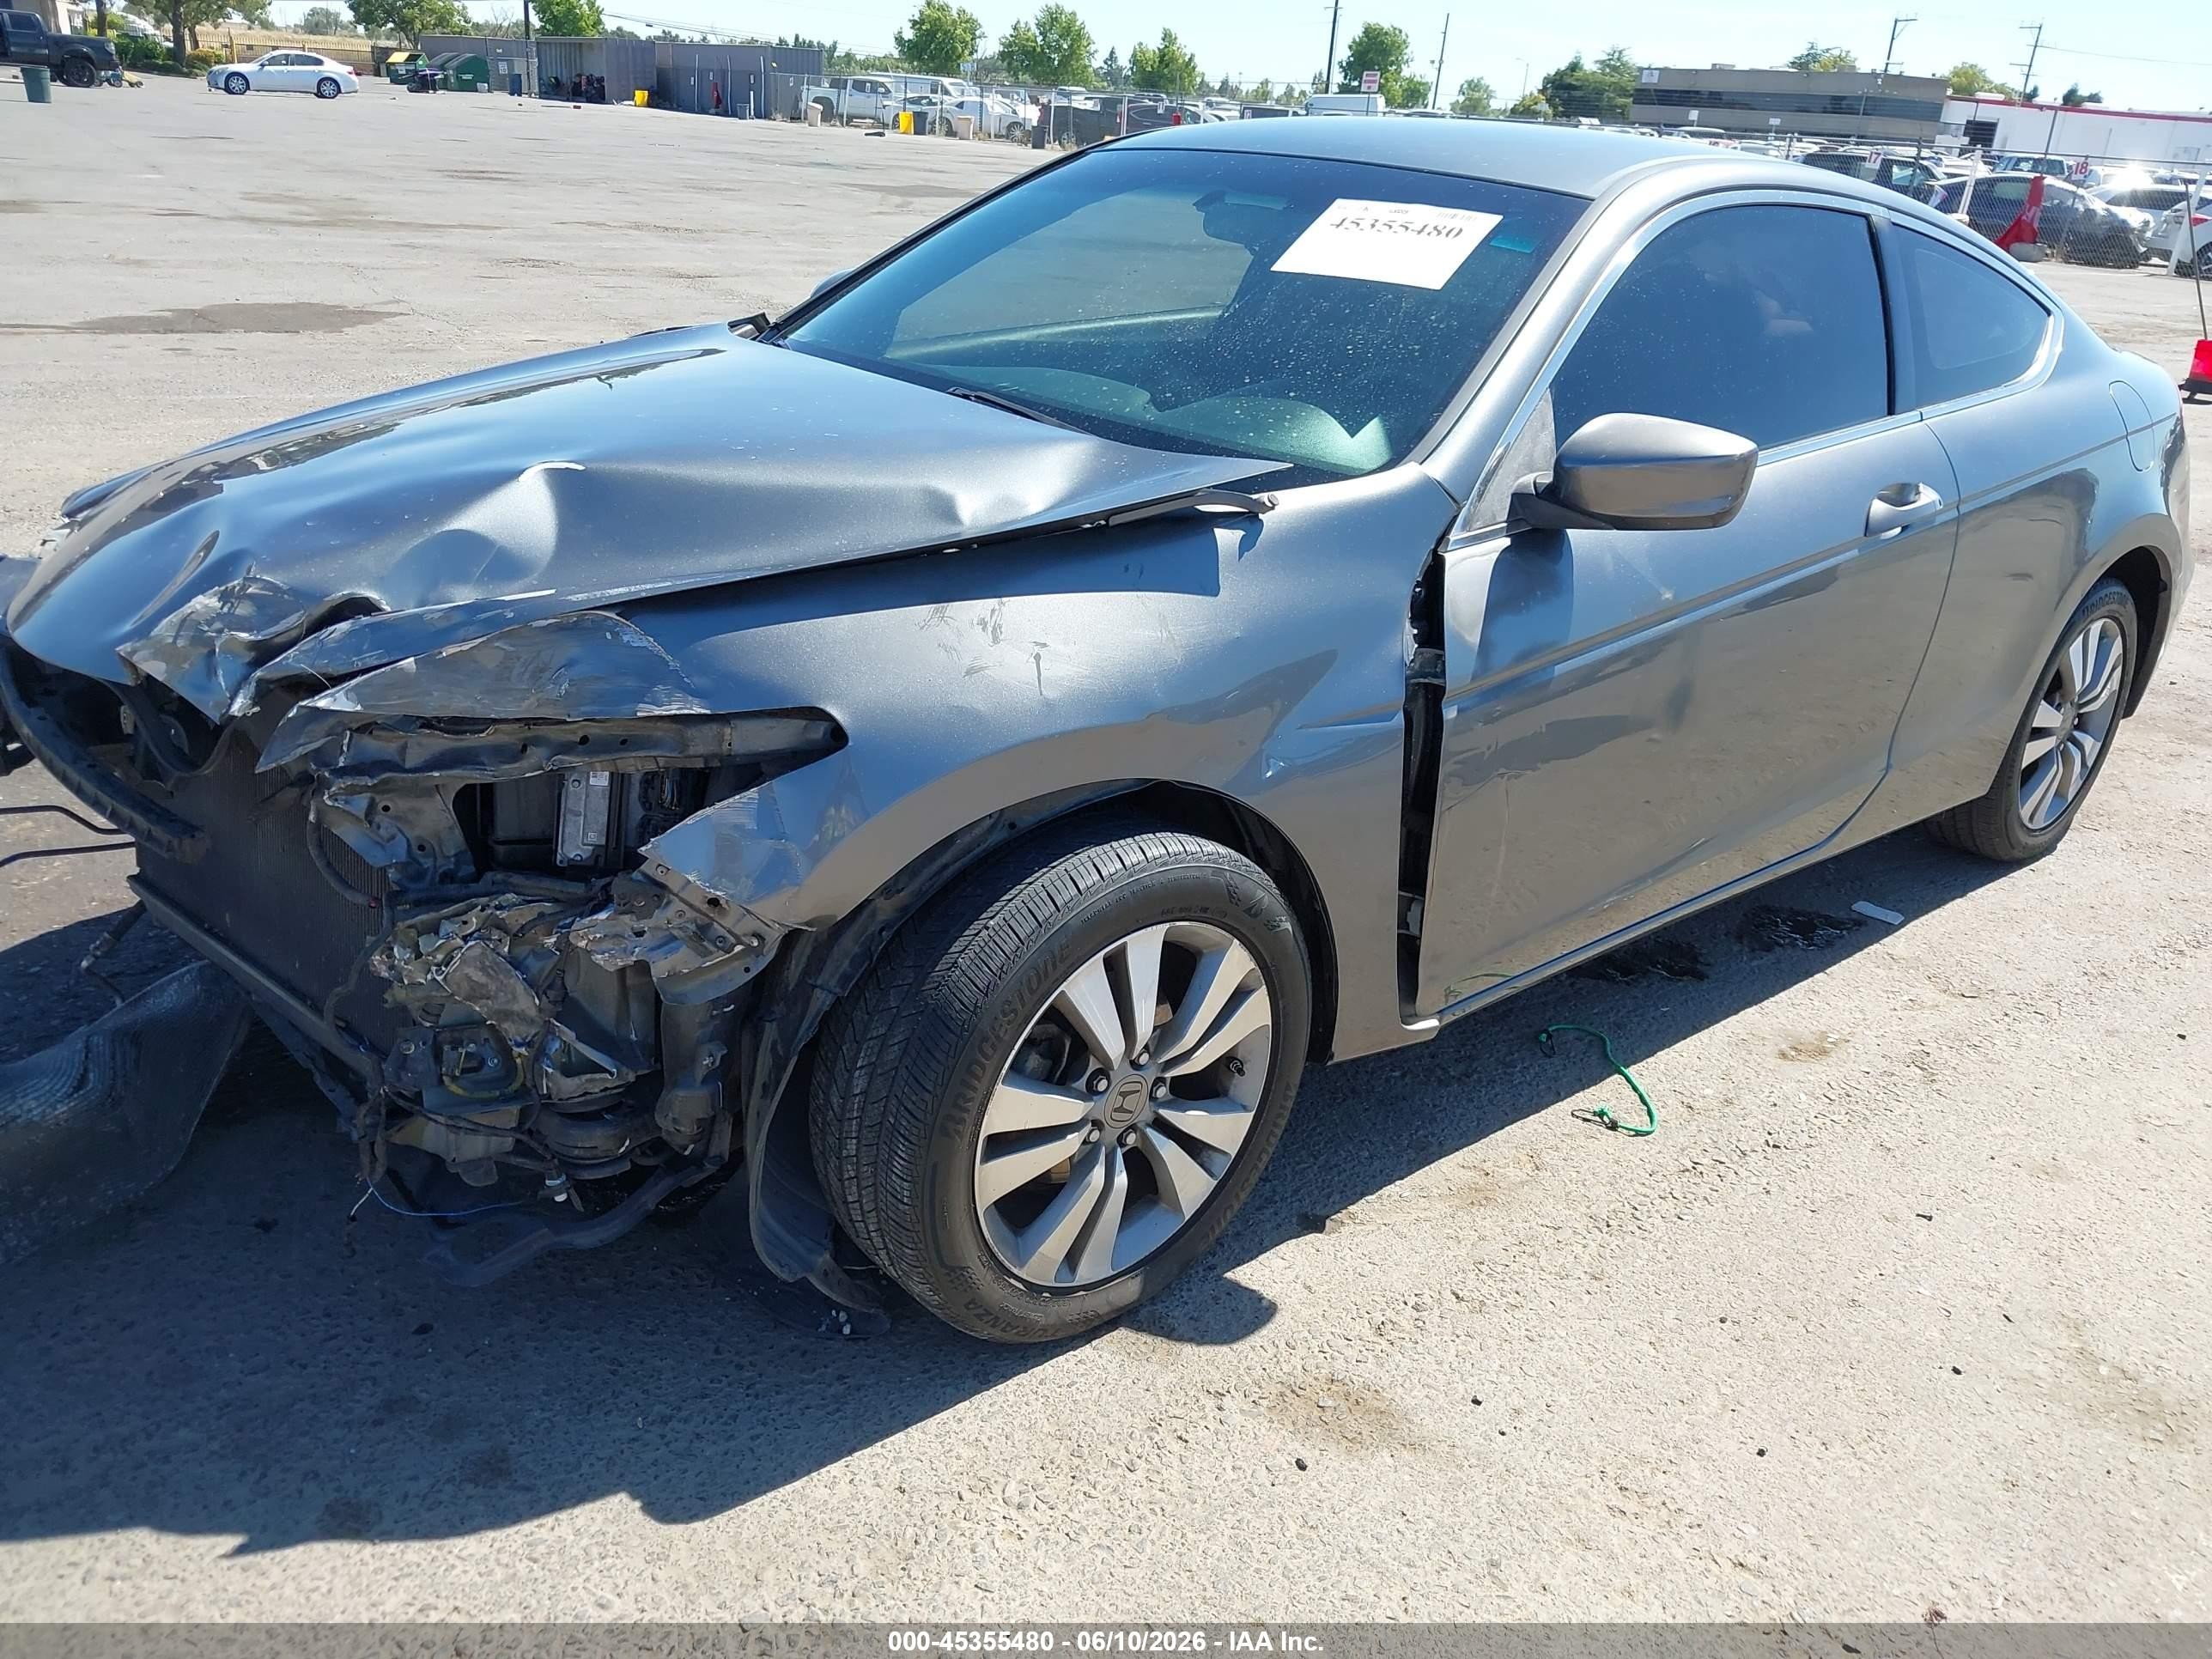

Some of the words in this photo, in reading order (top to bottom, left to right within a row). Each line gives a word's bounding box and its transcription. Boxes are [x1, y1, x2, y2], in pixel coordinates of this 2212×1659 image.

[1868, 151, 1881, 164] 17
[2074, 161, 2089, 175] 18
[1330, 216, 1463, 240] 45355480
